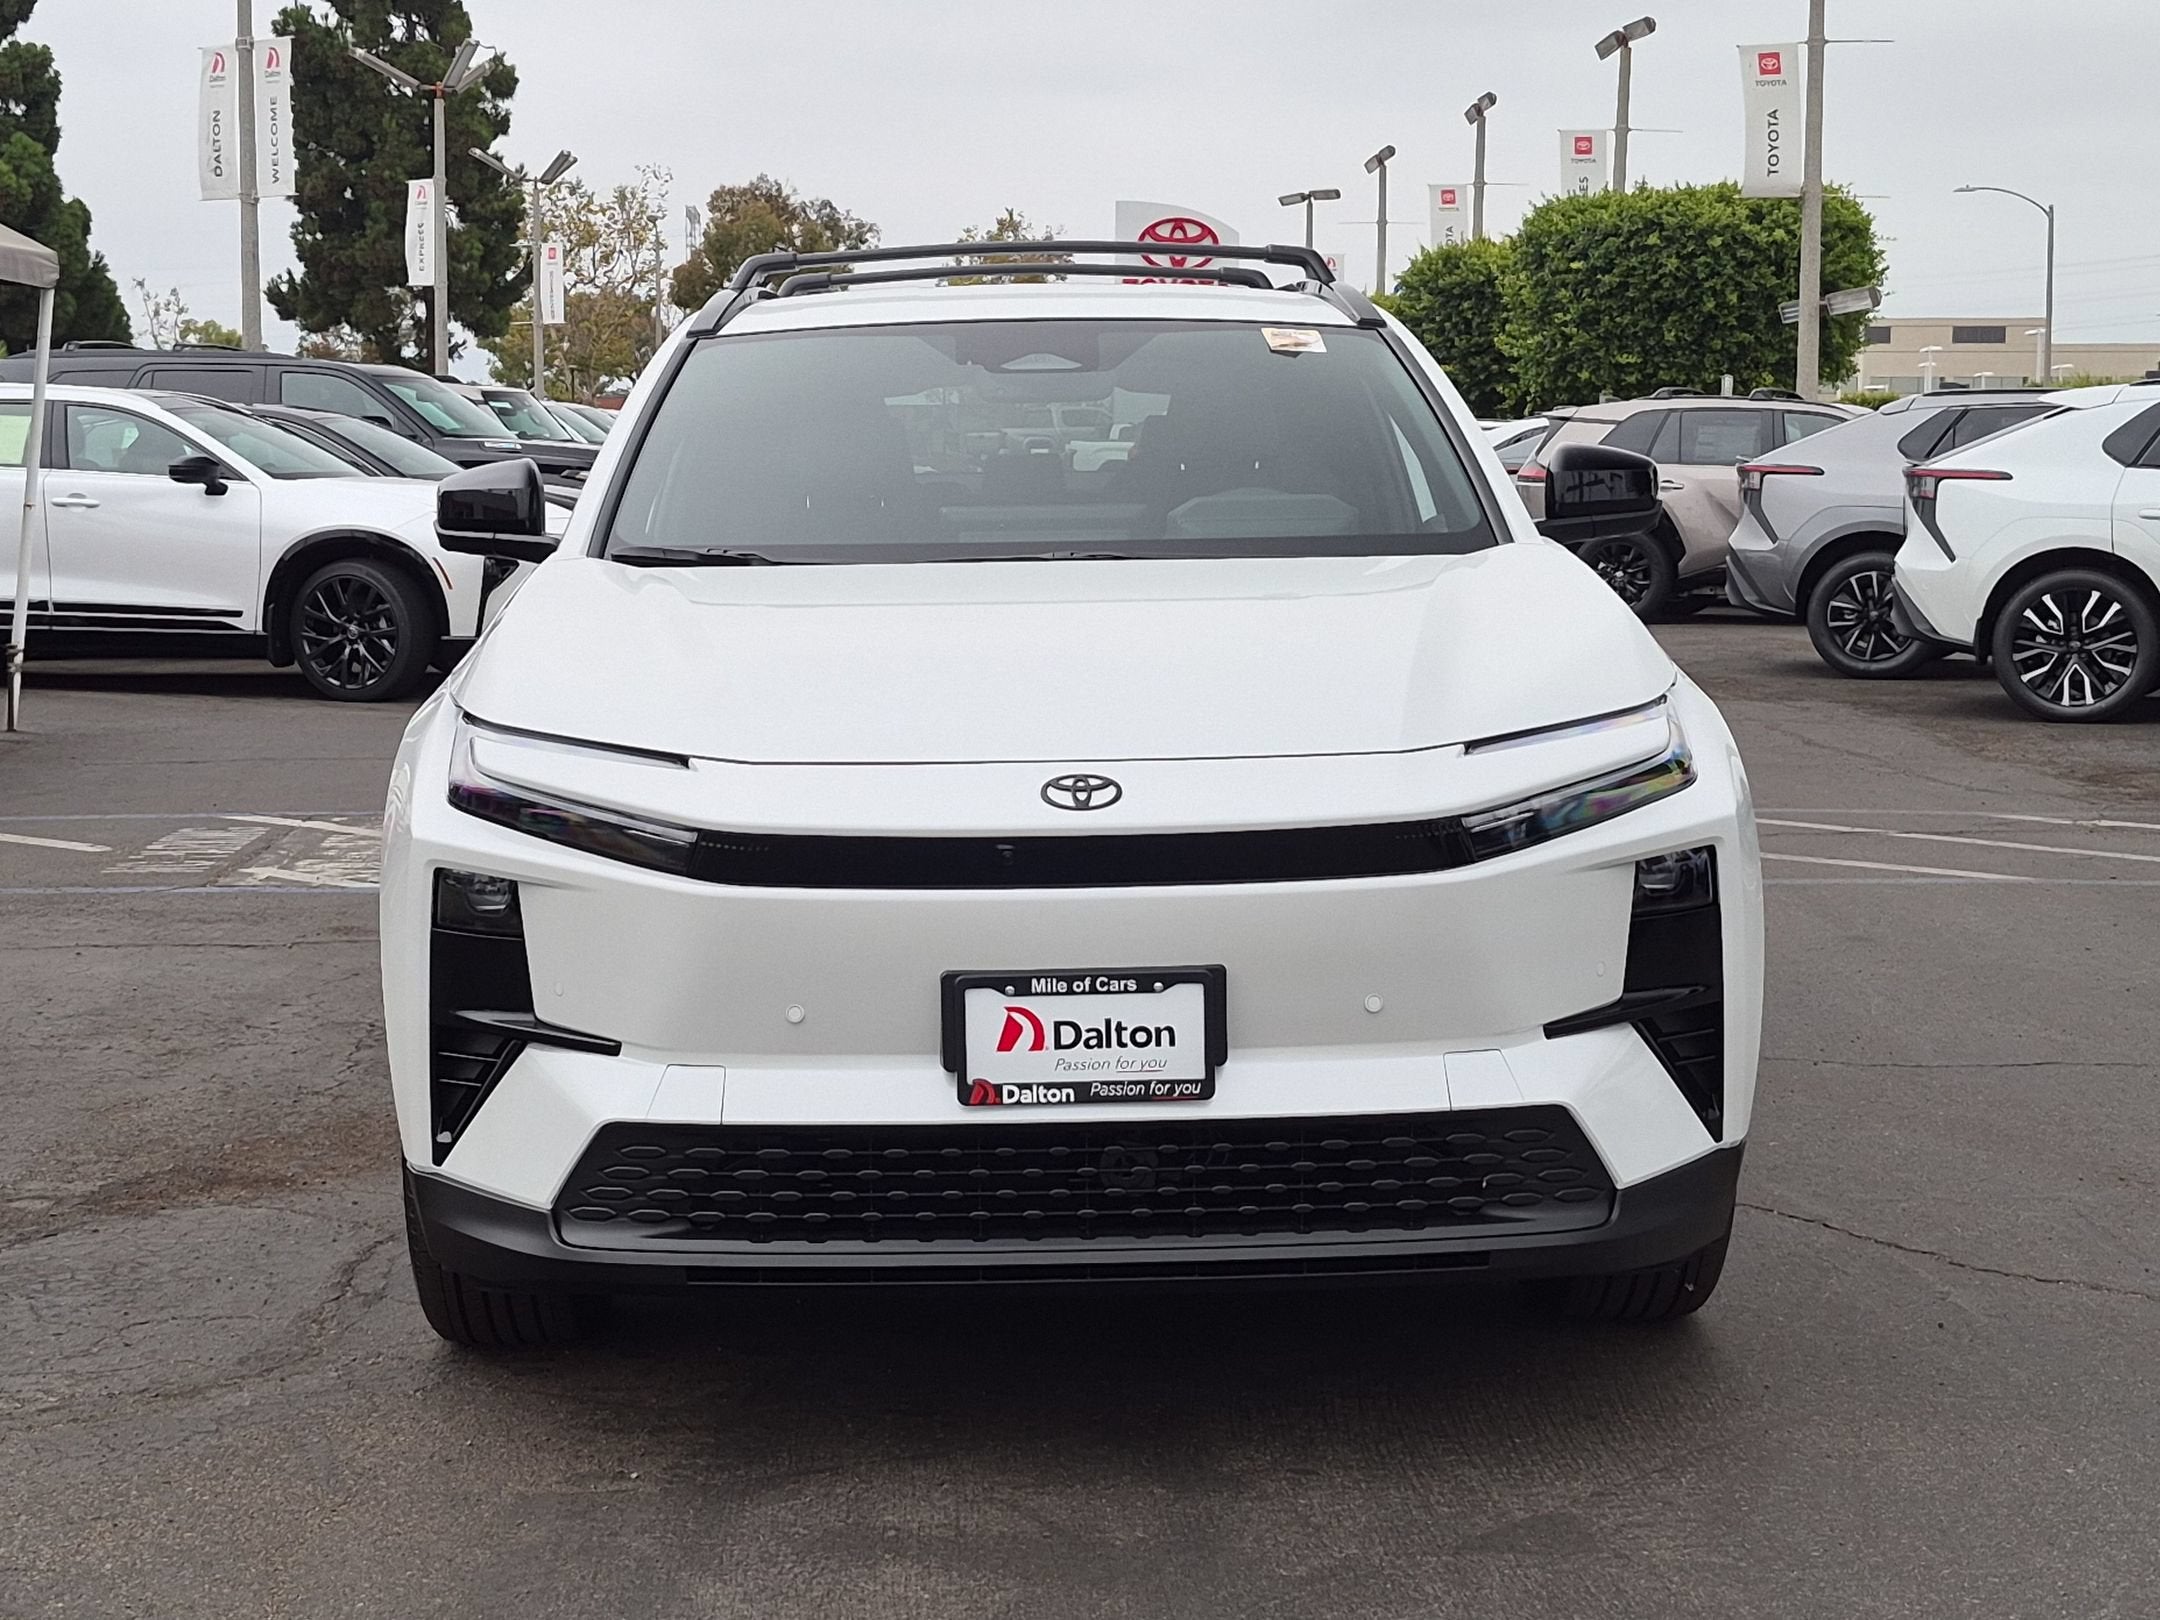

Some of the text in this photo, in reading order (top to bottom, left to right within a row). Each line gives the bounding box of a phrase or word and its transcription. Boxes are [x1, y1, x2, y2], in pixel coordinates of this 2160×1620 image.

[213, 110, 223, 177] DALTON
[270, 96, 280, 184] WELCOME
[1767, 109, 1780, 177] TOYOTA
[1446, 226, 1454, 247] OTA
[1031, 977, 1138, 994] Mile of Cars
[1053, 1017, 1176, 1050] Dalton
[1054, 1056, 1168, 1072] Passion for you
[1002, 1080, 1202, 1104] Dalton Passion for you
